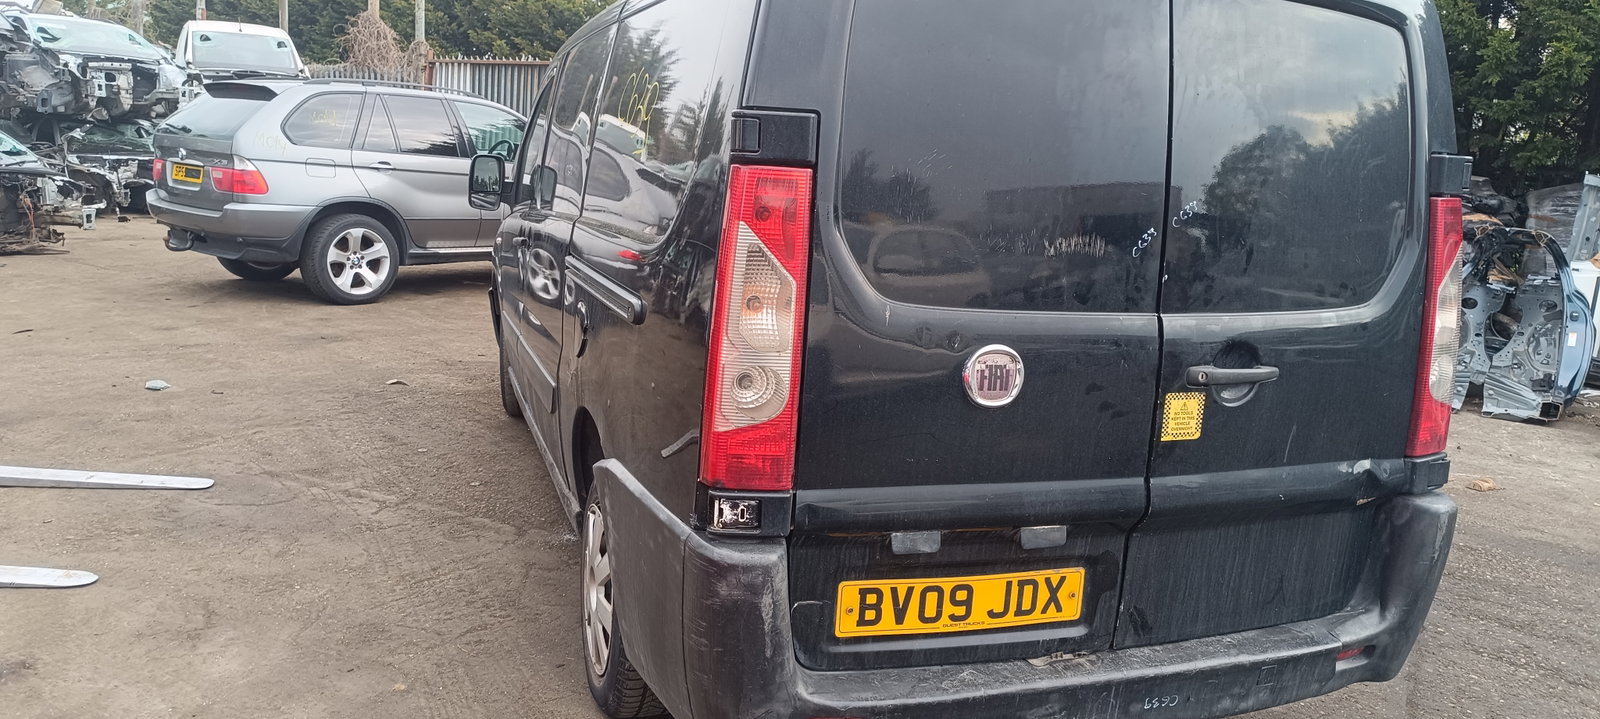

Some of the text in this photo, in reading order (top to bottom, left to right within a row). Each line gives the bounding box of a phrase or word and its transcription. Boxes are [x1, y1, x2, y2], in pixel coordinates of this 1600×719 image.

[1173, 201, 1198, 227] C639
[1133, 228, 1157, 258] C639
[976, 365, 1013, 391] FIAT
[856, 575, 1067, 627] BV09 JDX
